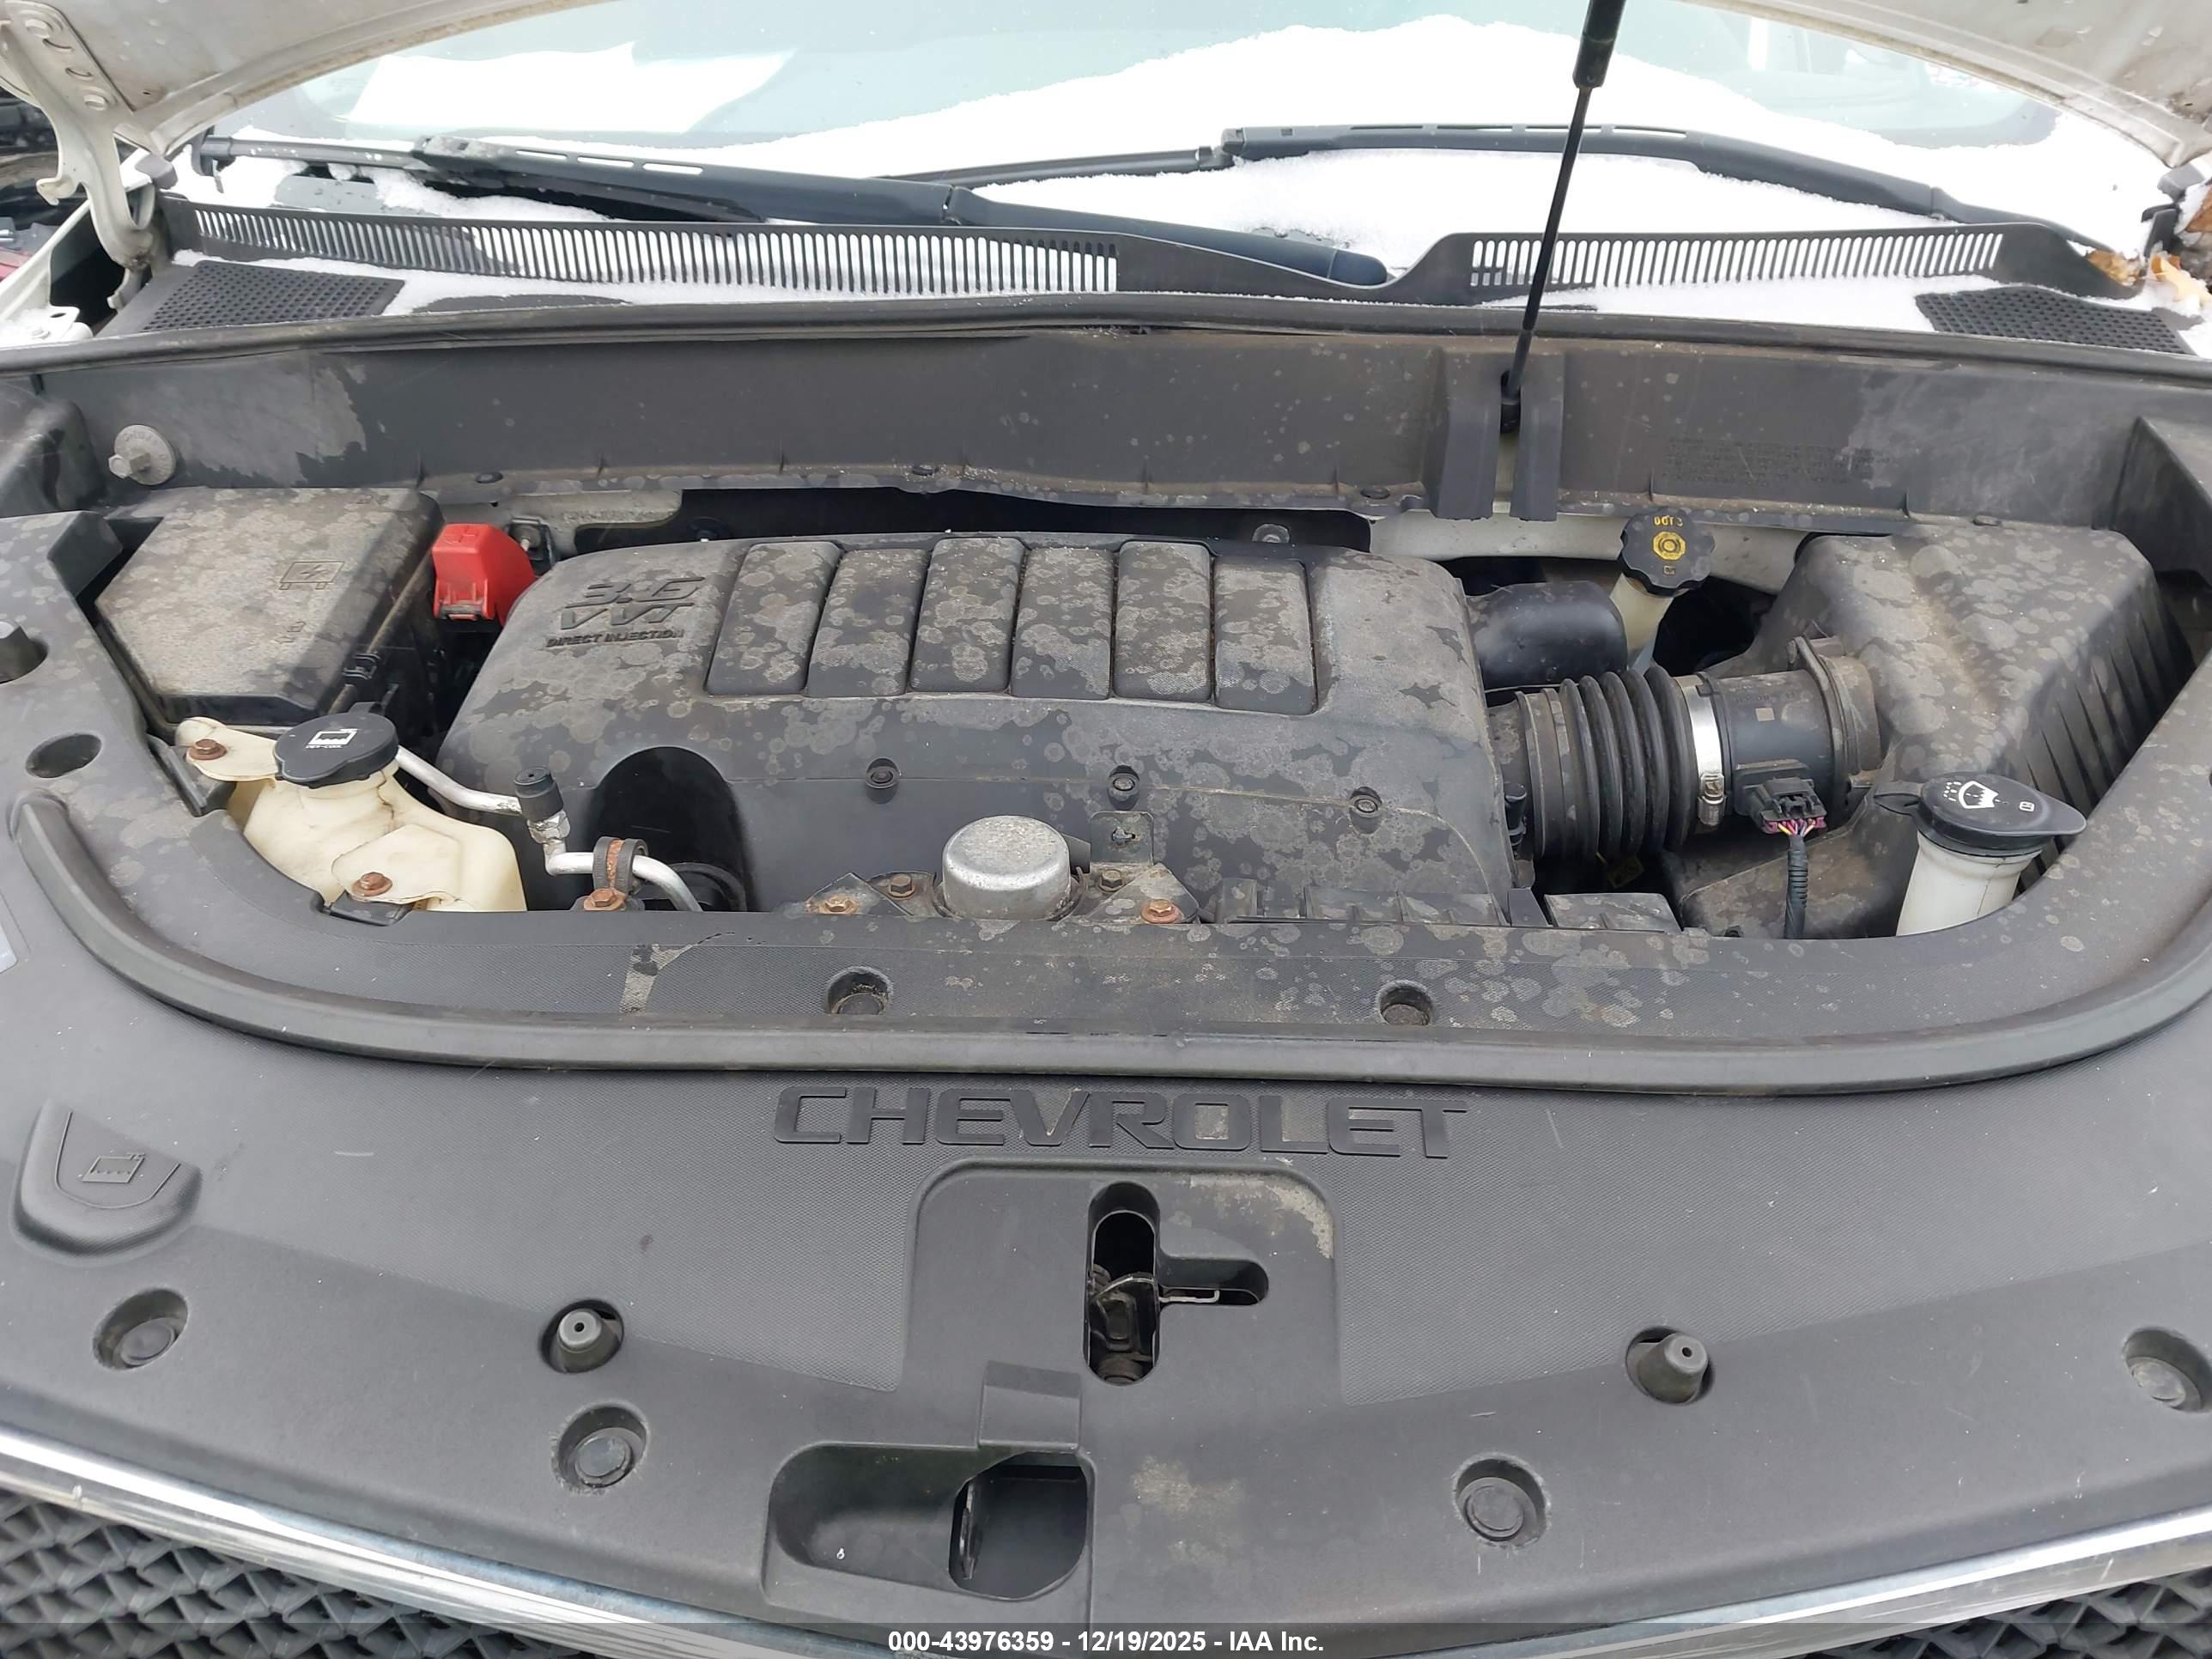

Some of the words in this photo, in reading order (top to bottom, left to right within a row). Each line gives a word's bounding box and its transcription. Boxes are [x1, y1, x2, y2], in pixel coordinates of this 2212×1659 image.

[563, 576, 706, 609] 3.6
[560, 602, 695, 630] VVT
[545, 633, 603, 647] DIRECT
[604, 629, 685, 643] INJECTION
[774, 1085, 1468, 1159] CHEVROLET
